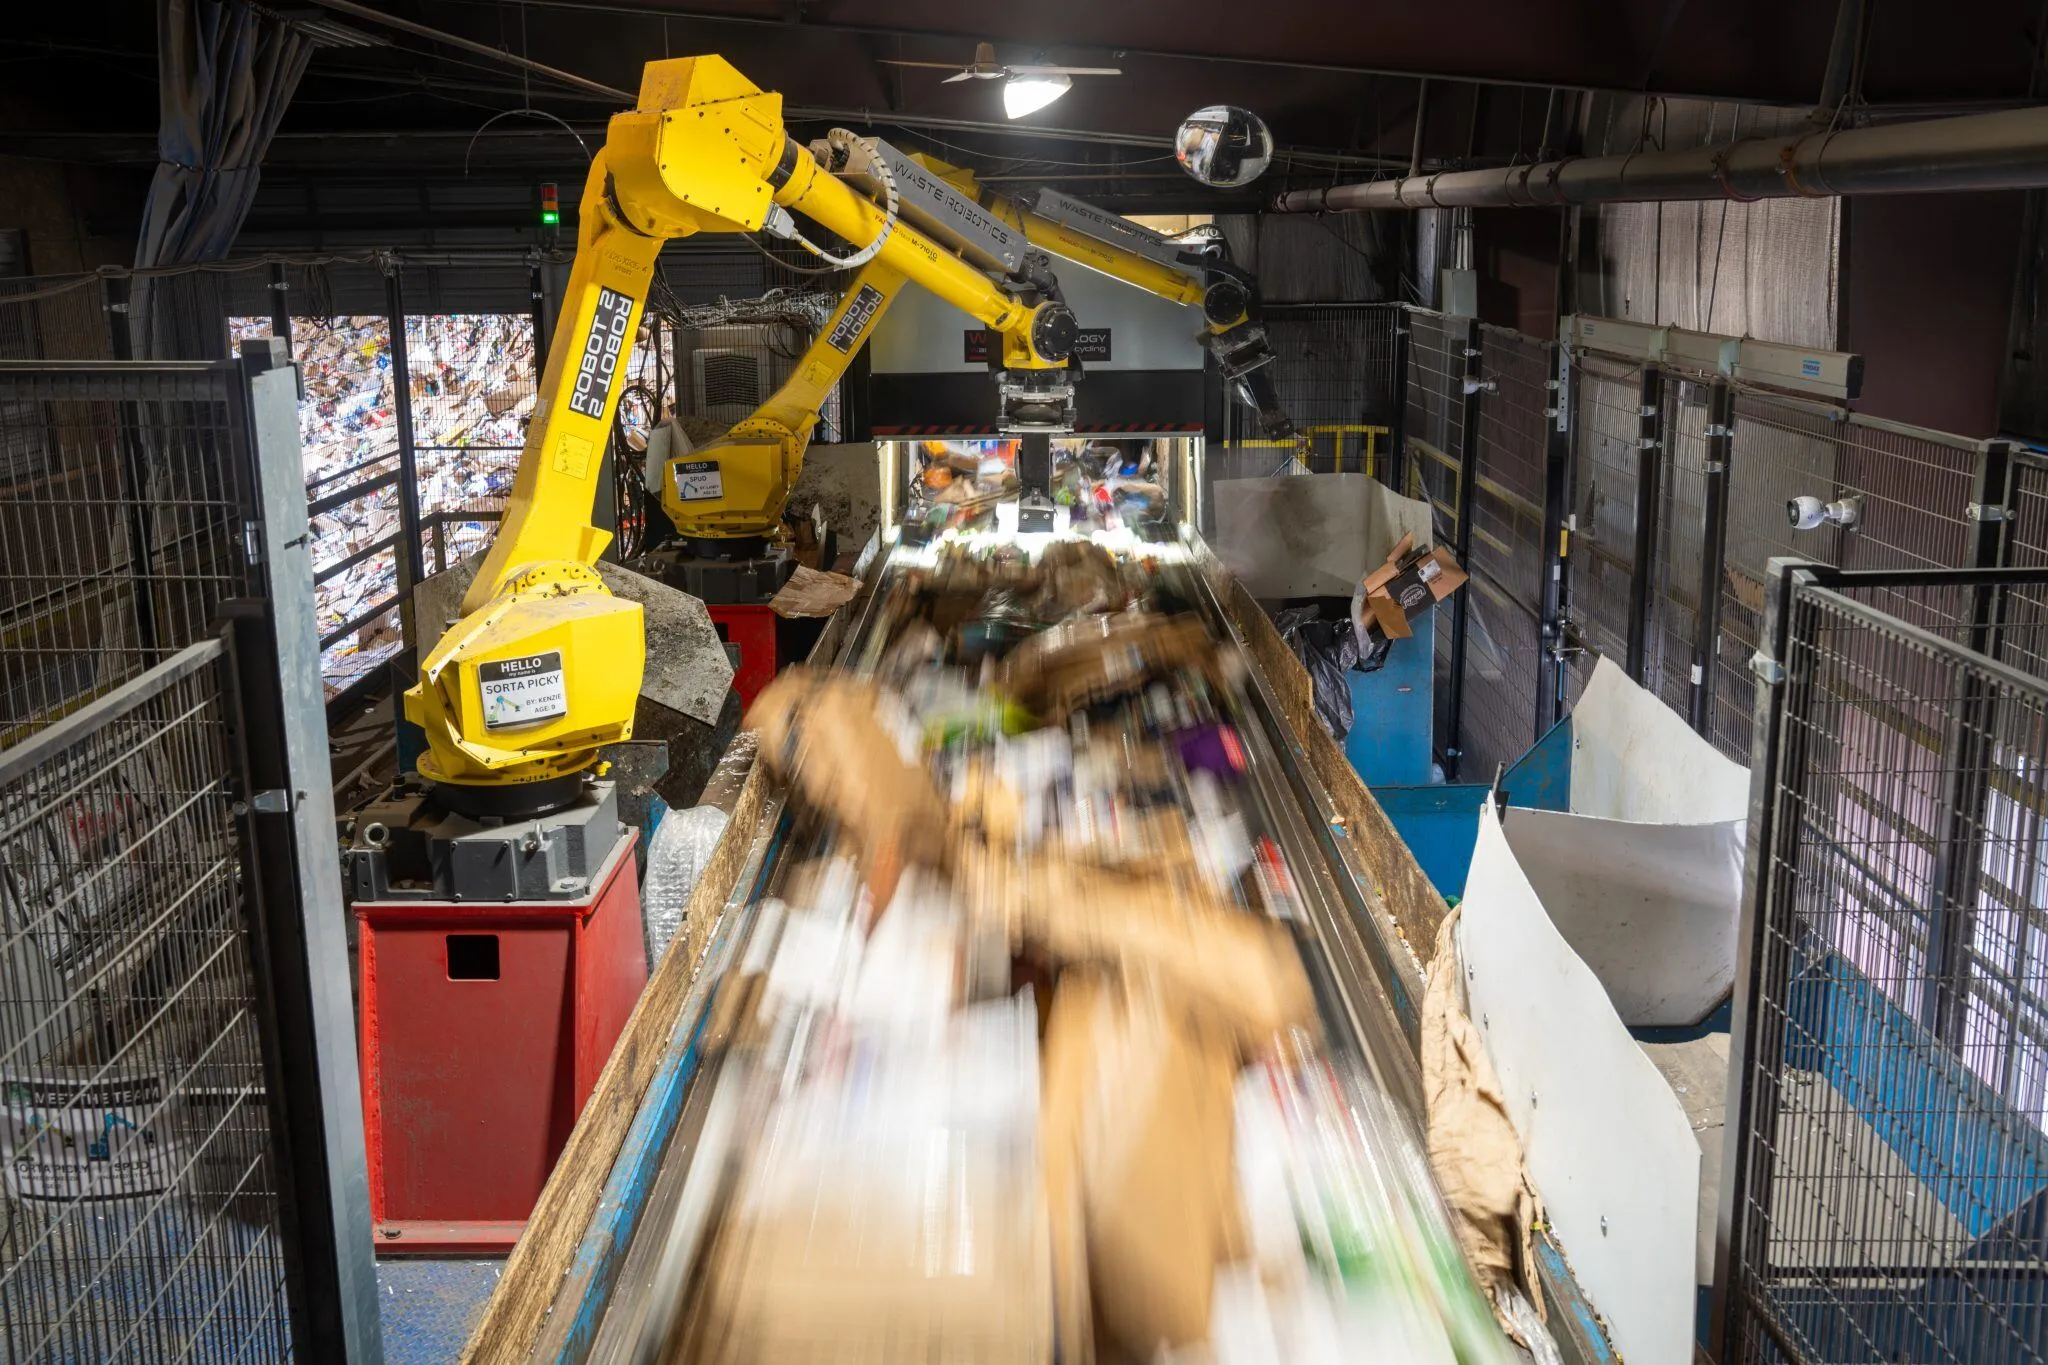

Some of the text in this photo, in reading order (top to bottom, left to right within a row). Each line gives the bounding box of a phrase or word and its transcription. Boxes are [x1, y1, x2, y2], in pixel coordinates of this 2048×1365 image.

[895, 160, 1009, 245] WASTE ROBOTICS
[1060, 199, 1103, 223] WASTE
[874, 214, 899, 233] FAC
[828, 294, 865, 346] ROBOT
[847, 292, 884, 345] ROBOT
[570, 314, 607, 412] ROBOT
[599, 289, 616, 310] 2
[597, 296, 633, 393] ROBOT
[1074, 345, 1106, 353] cycling
[588, 397, 605, 418] 2
[685, 462, 708, 470] HELLO
[689, 475, 707, 483] SPUD
[500, 657, 542, 673] HELLO
[486, 674, 560, 695] SORTA PICKY
[526, 693, 561, 706] BY: KENZIE
[534, 705, 550, 713] AGE:
[112, 1086, 160, 1103] TEAM
